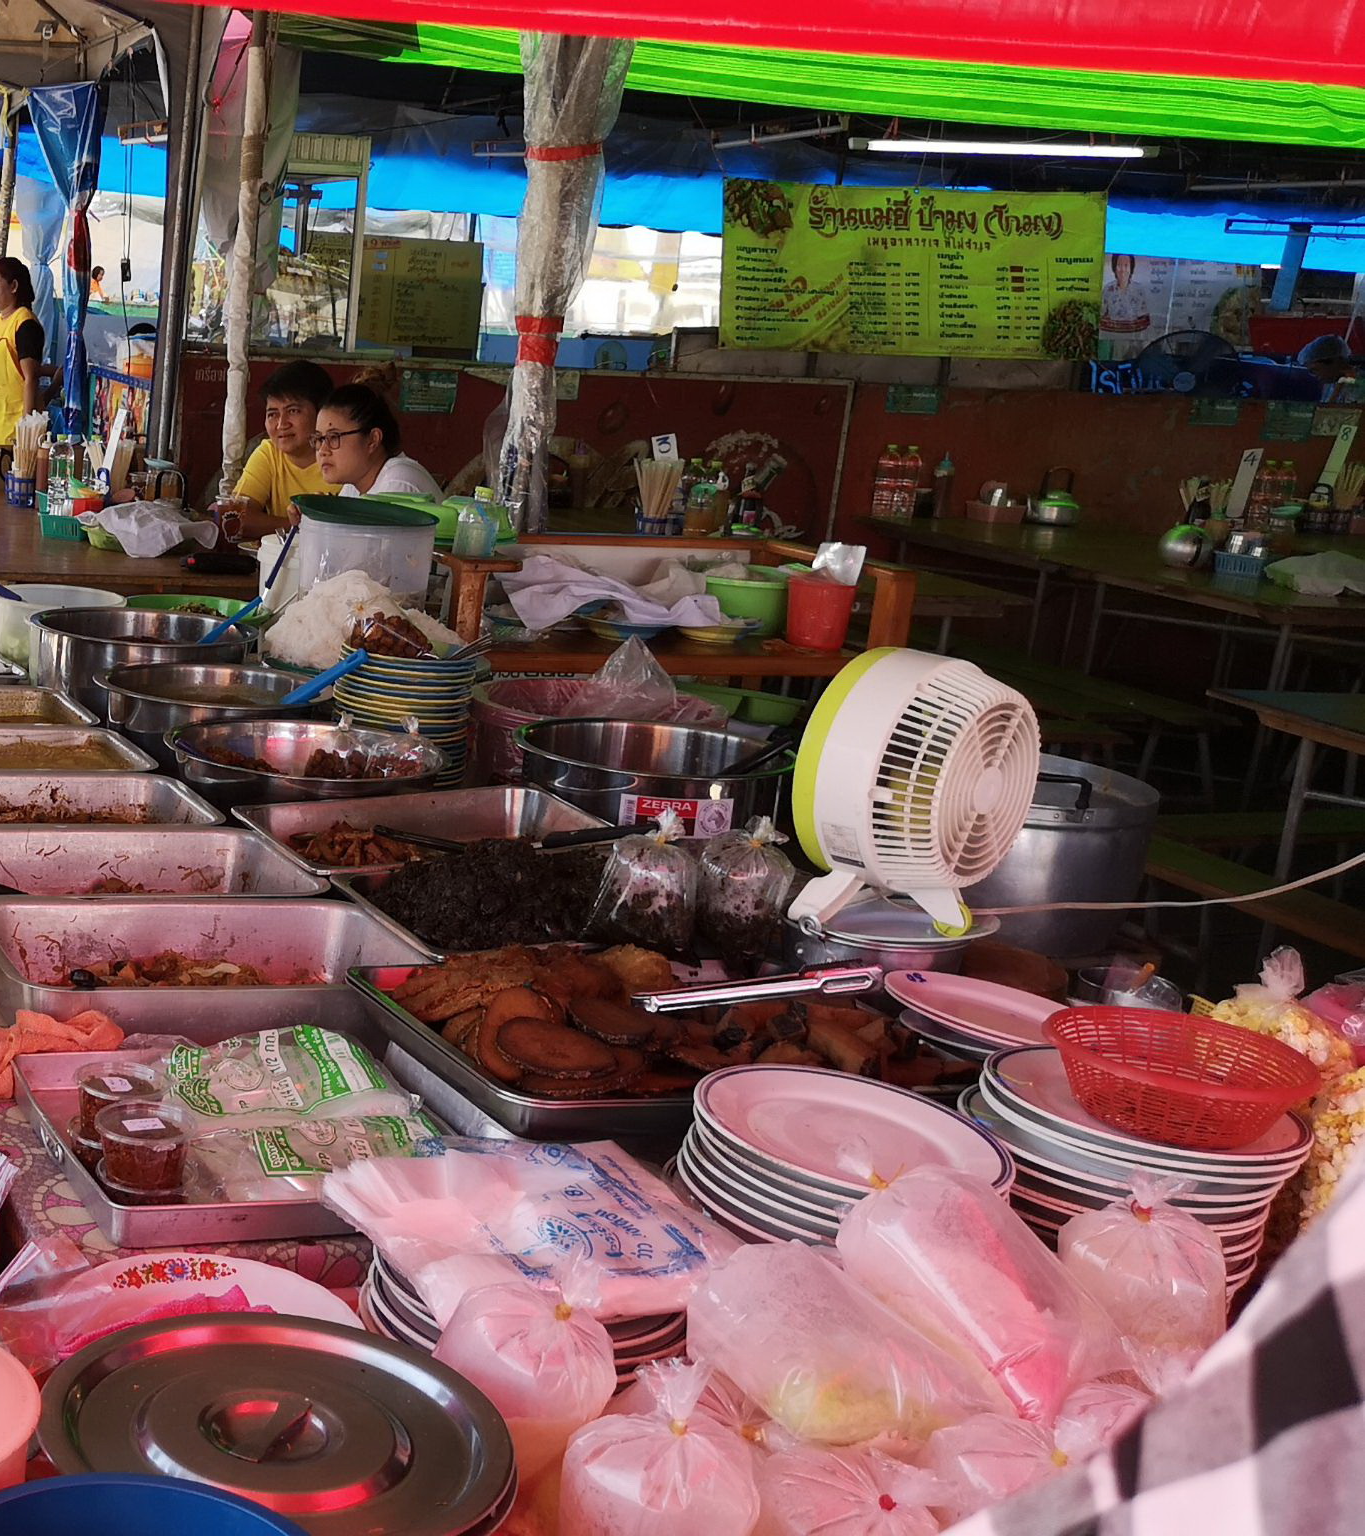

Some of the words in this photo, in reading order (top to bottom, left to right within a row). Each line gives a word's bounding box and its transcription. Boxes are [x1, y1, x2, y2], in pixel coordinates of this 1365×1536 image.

[1341, 427, 1352, 441] 8
[656, 436, 671, 454] 3
[1244, 451, 1258, 466] 4
[641, 798, 692, 812] ZEBRA
